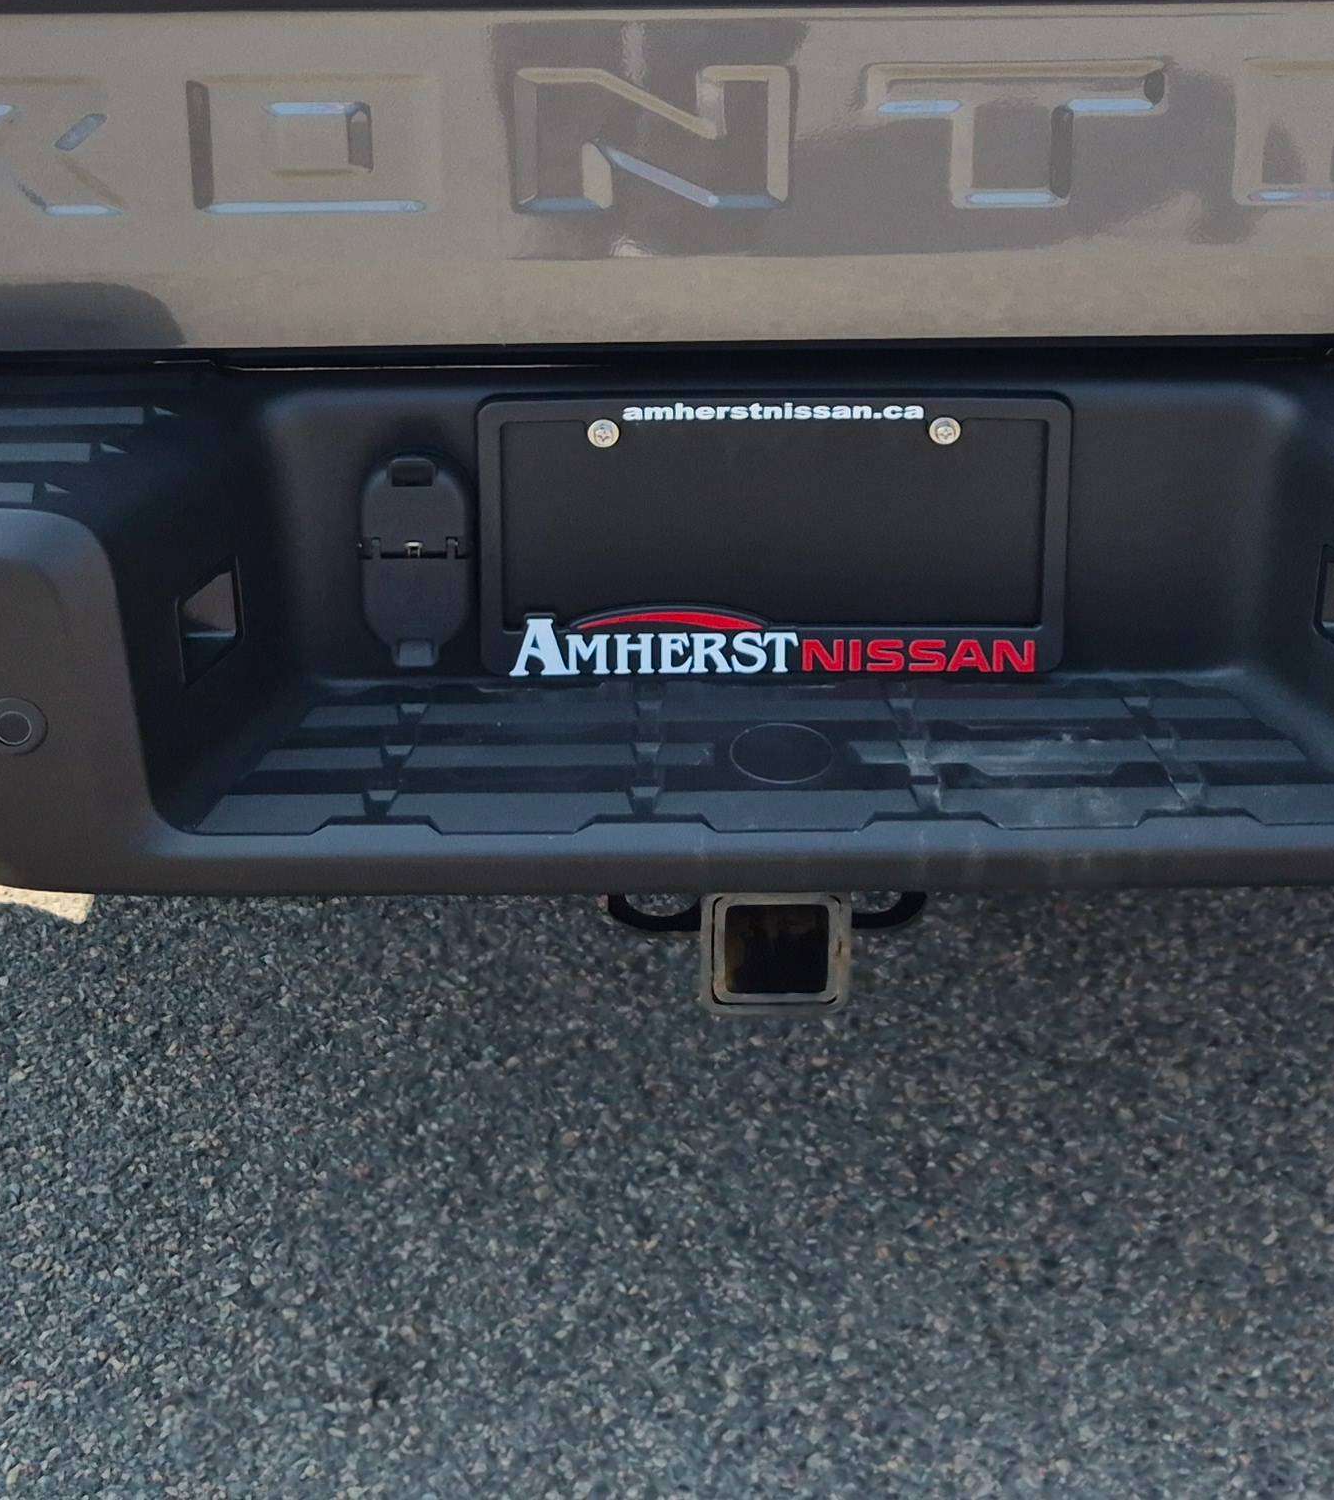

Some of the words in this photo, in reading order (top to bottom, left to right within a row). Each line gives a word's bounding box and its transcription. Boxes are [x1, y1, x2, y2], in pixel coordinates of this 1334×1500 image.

[623, 402, 924, 421] amherstnissan.ca
[509, 618, 799, 677] AMHERST
[801, 639, 1036, 673] NISSAN
